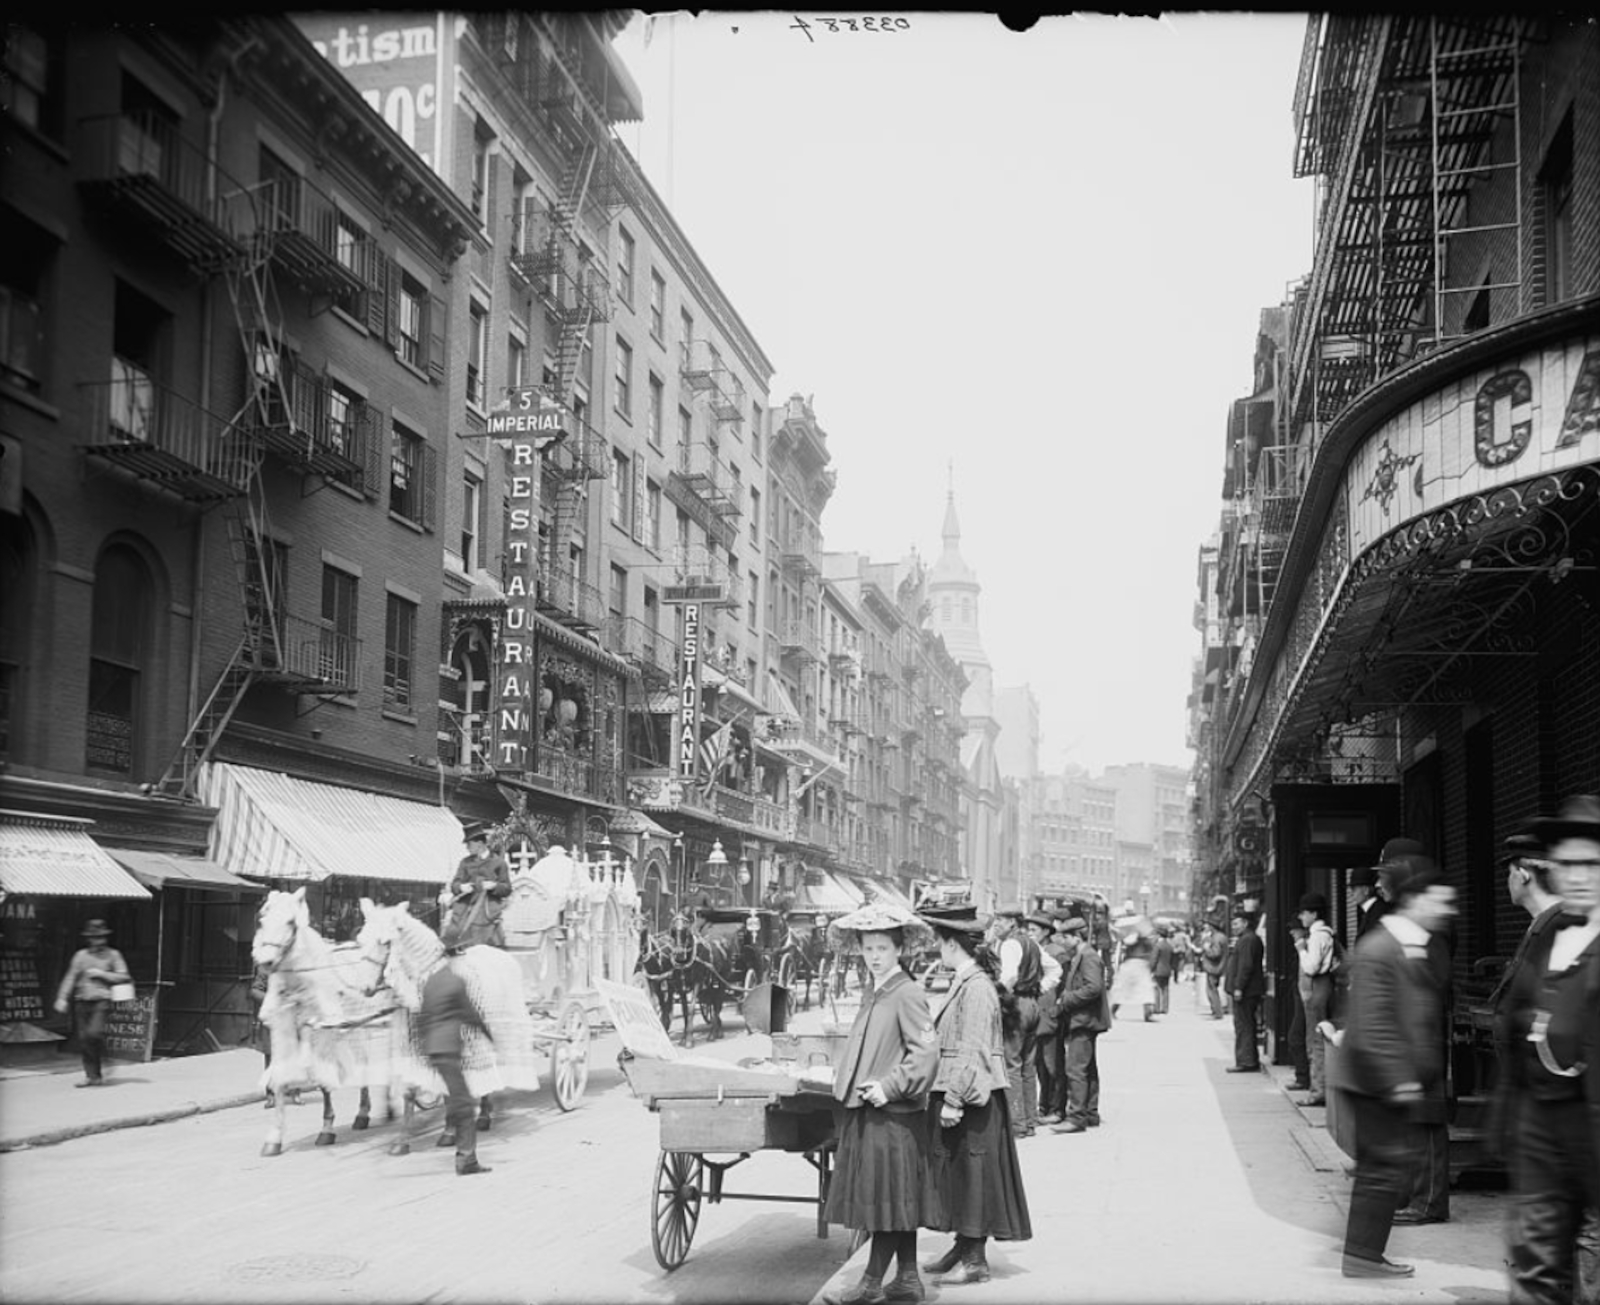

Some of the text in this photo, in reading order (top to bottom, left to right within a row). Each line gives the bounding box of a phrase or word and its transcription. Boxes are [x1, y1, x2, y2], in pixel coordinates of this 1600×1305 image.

[320, 25, 436, 68] tism
[519, 391, 532, 410] 5
[487, 414, 561, 433] IMPERIAL
[500, 444, 532, 764] RESTAURANT
[681, 605, 698, 776] RESTAURANT
[104, 1022, 145, 1035] INESE
[106, 1036, 148, 1051] CERIES
